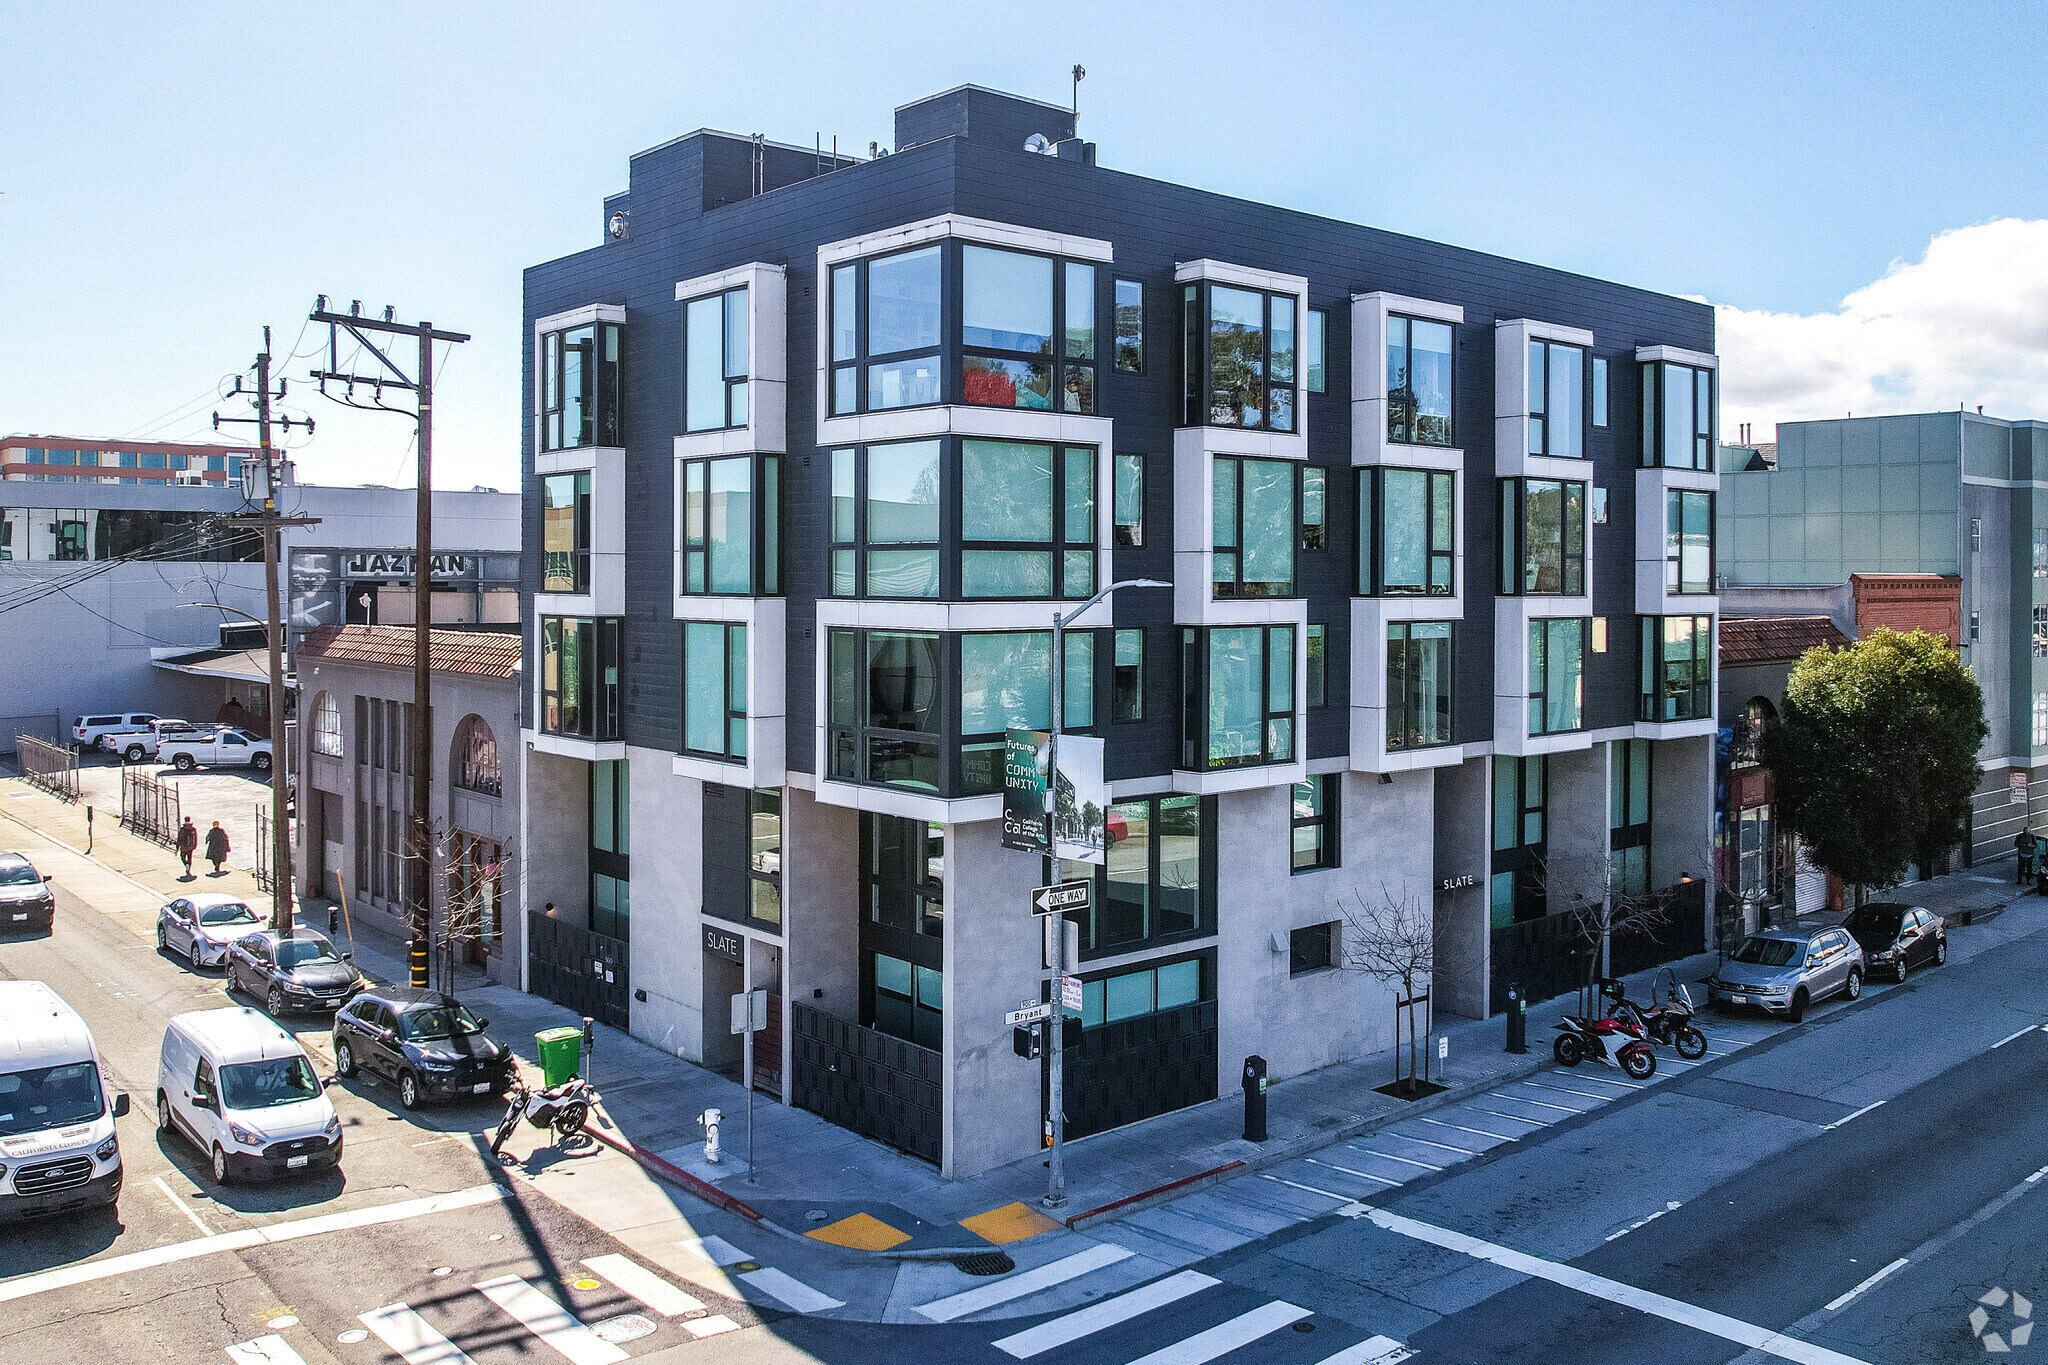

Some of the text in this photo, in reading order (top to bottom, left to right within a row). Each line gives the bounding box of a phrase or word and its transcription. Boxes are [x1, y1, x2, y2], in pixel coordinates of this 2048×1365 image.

[349, 554, 465, 575] JAZAN
[1007, 739, 1035, 752] Futures
[1006, 751, 1016, 761] of
[1006, 763, 1035, 778] COMM
[1005, 776, 1039, 791] UNITY
[1443, 874, 1473, 890] SLATE
[1048, 888, 1085, 905] ONE WAY
[707, 931, 737, 956] SLATE
[1013, 1007, 1042, 1021] Bryant
[11, 1139, 90, 1157] CALIFORNIA CLOSETS
